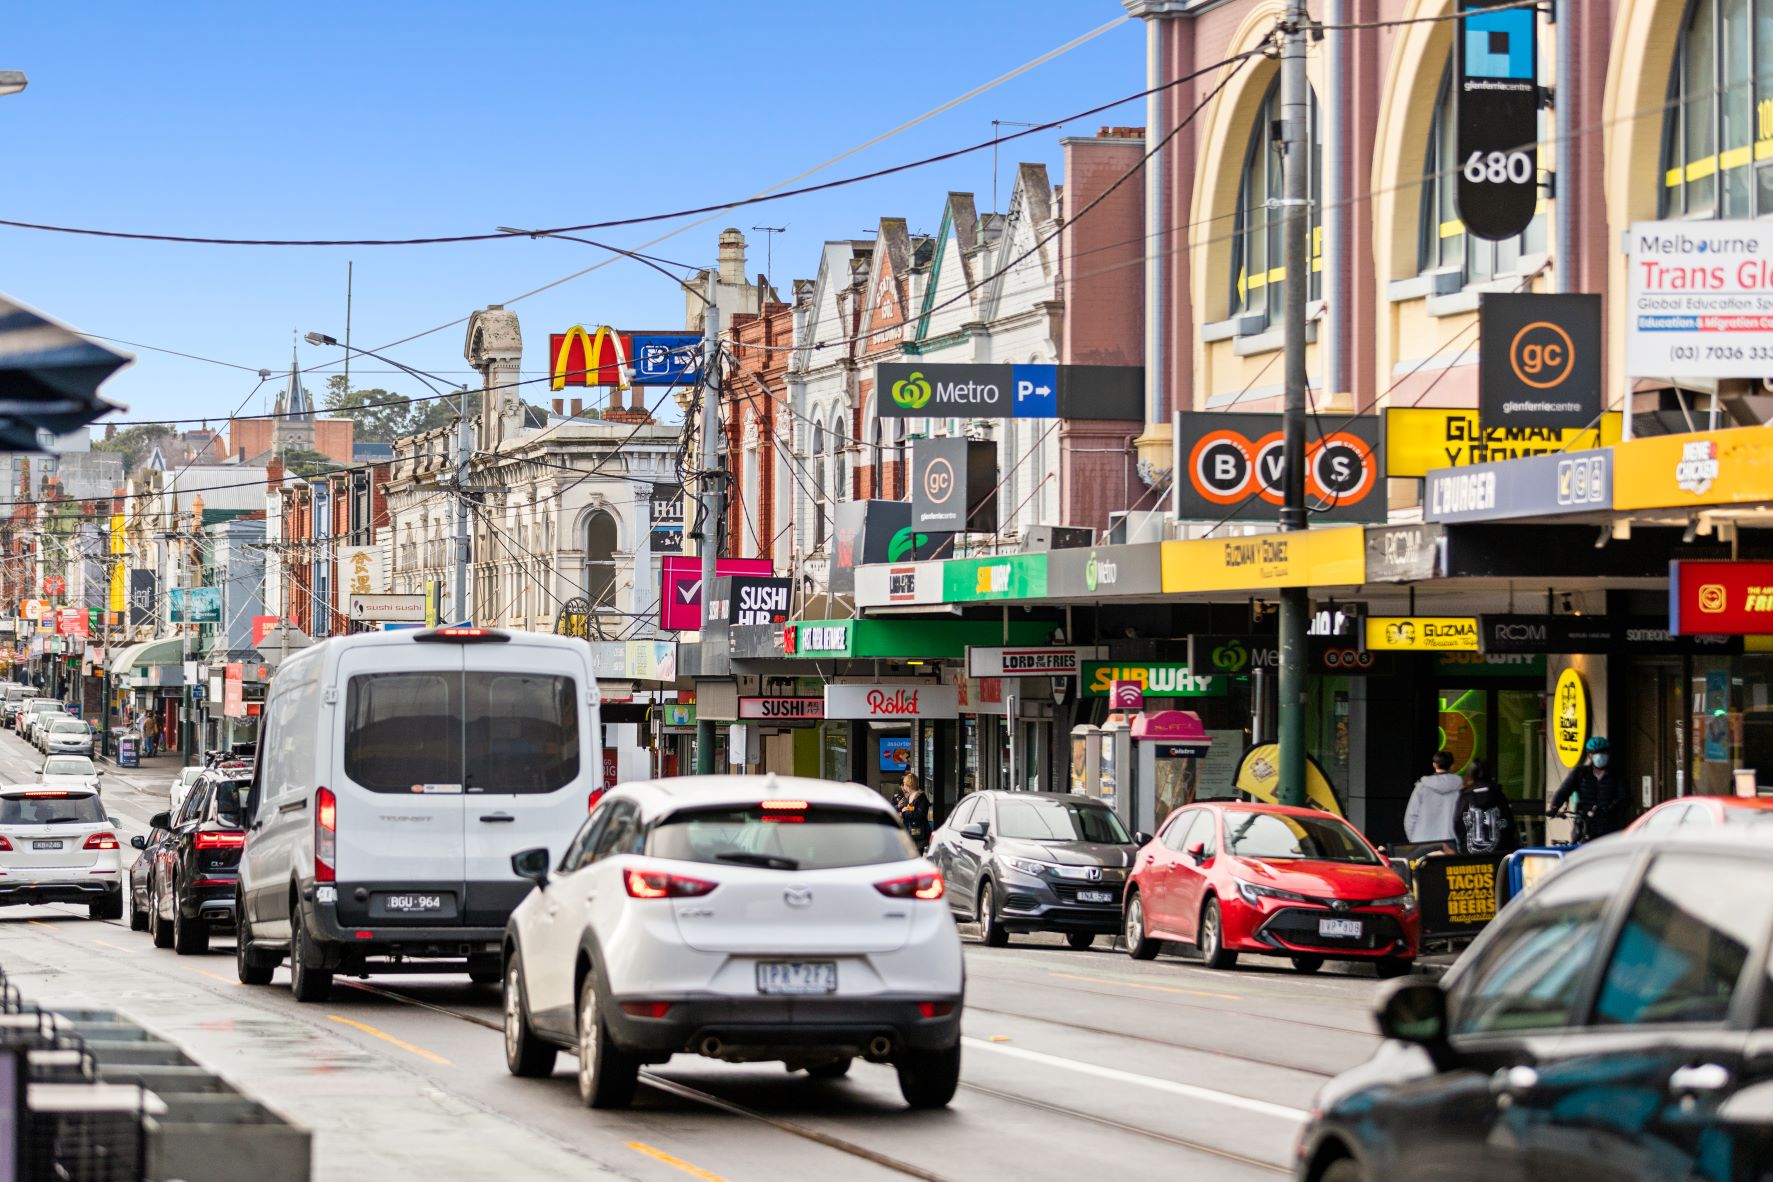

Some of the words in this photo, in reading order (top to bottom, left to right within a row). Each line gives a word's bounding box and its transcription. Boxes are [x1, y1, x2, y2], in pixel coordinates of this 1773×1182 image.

[1463, 150, 1533, 184] 680
[1640, 235, 1759, 254] Melbourne
[1640, 260, 1725, 289] Trans
[1637, 297, 1681, 310] Global
[1686, 297, 1752, 310] Education
[1639, 317, 1695, 329] Education
[1705, 317, 1757, 331] Migration
[1522, 344, 1563, 374] gc
[1670, 346, 1699, 361] (03)
[1705, 347, 1744, 360] 7036
[936, 380, 999, 404] Metro
[1018, 381, 1034, 401] P
[1502, 401, 1582, 414] glenferriecentre
[930, 472, 949, 494] gc
[1432, 471, 1496, 514] L'BURGER
[1097, 560, 1117, 584] Metro
[740, 586, 787, 610] SUSHI
[1424, 624, 1477, 637] GUZMA
[1495, 625, 1546, 640] ROOM
[1003, 655, 1034, 669] LORD
[1047, 652, 1076, 668] FRIES
[762, 701, 804, 716] SUSHI
[1446, 864, 1493, 875] BURRITOS
[1447, 873, 1494, 890] TACOS
[1448, 888, 1494, 900] nachos
[1448, 899, 1495, 915] BEERS
